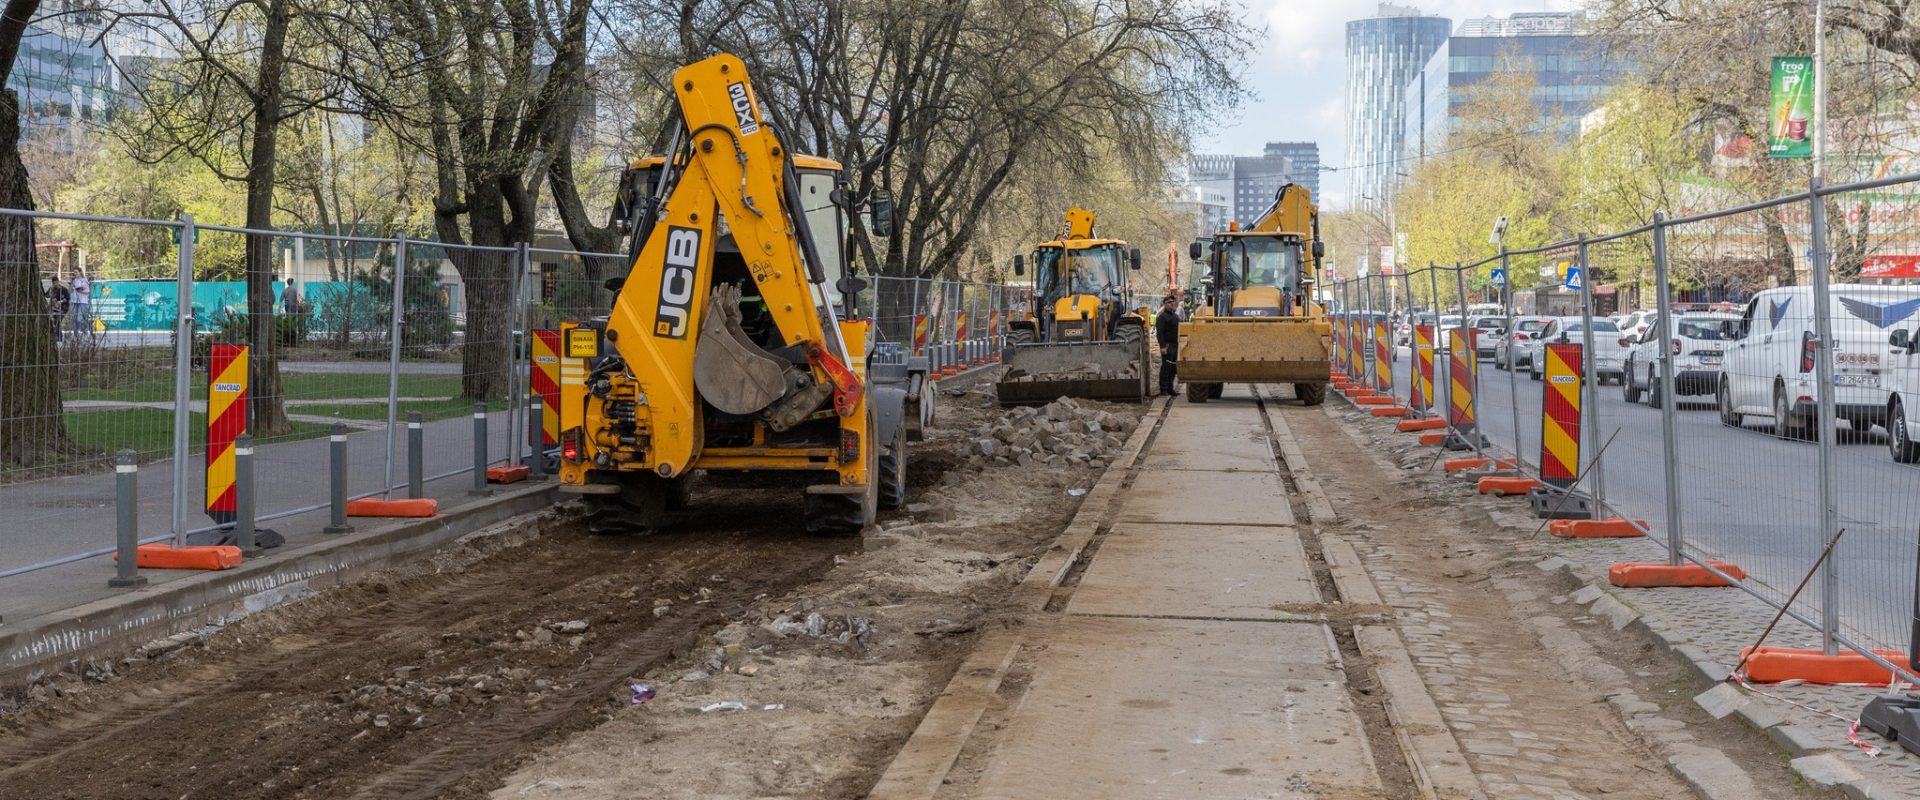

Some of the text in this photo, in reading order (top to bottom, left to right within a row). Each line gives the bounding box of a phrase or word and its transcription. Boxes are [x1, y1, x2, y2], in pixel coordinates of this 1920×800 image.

[729, 83, 754, 125] 3CX
[660, 229, 699, 337] JCB
[215, 384, 241, 392] TANCRAD
